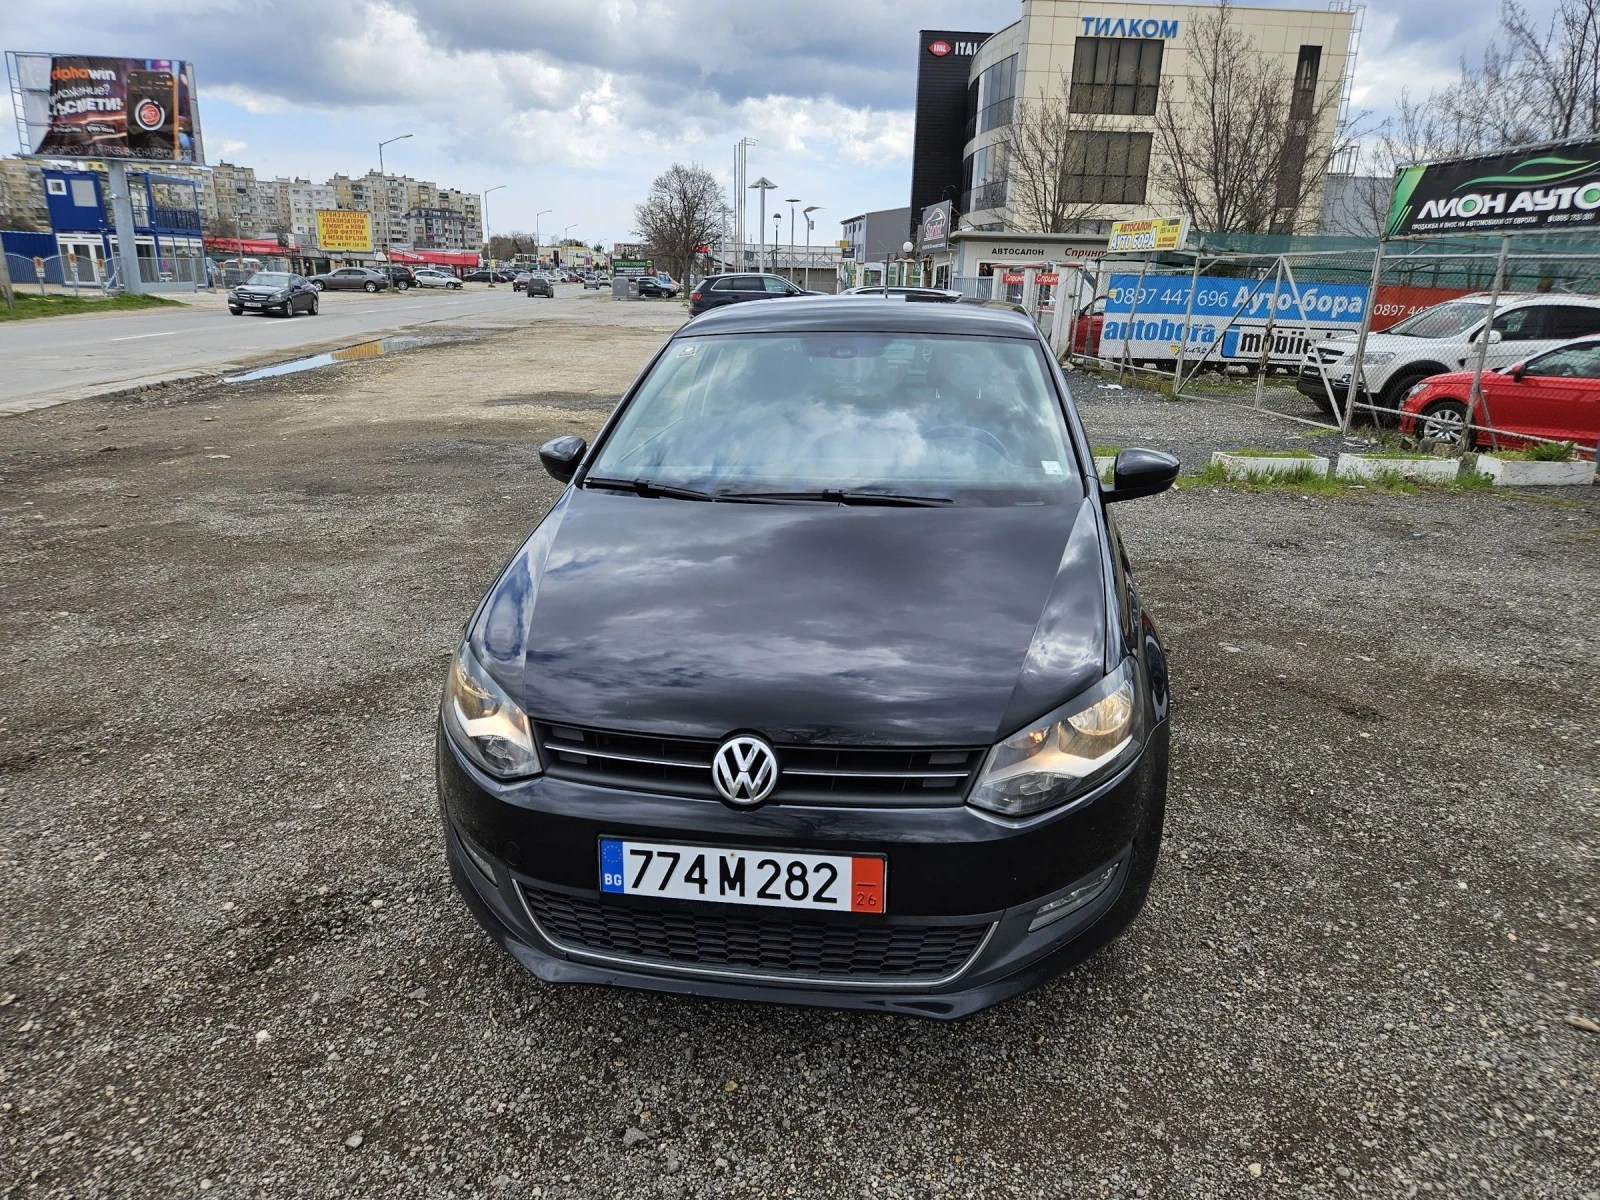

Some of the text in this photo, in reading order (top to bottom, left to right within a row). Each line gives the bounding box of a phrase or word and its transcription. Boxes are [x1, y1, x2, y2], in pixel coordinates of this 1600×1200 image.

[1082, 17, 1178, 38] ТИЛКОМ
[1417, 182, 1600, 219] ЛИОН АУТО
[1120, 221, 1153, 232] АВТОСАЛОН
[1109, 226, 1157, 250] АУТО БОРА
[991, 248, 1044, 256] АВТОСАЛОН
[1005, 273, 1025, 283] Сприн
[1114, 287, 1229, 307] 0897 447 696
[1232, 286, 1363, 318] Ауто-бора
[1373, 303, 1405, 316] 0897
[1103, 319, 1216, 343] autobora
[604, 873, 622, 887] BG
[629, 849, 708, 894] 774
[756, 859, 838, 904] 282
[856, 892, 877, 906] 26
